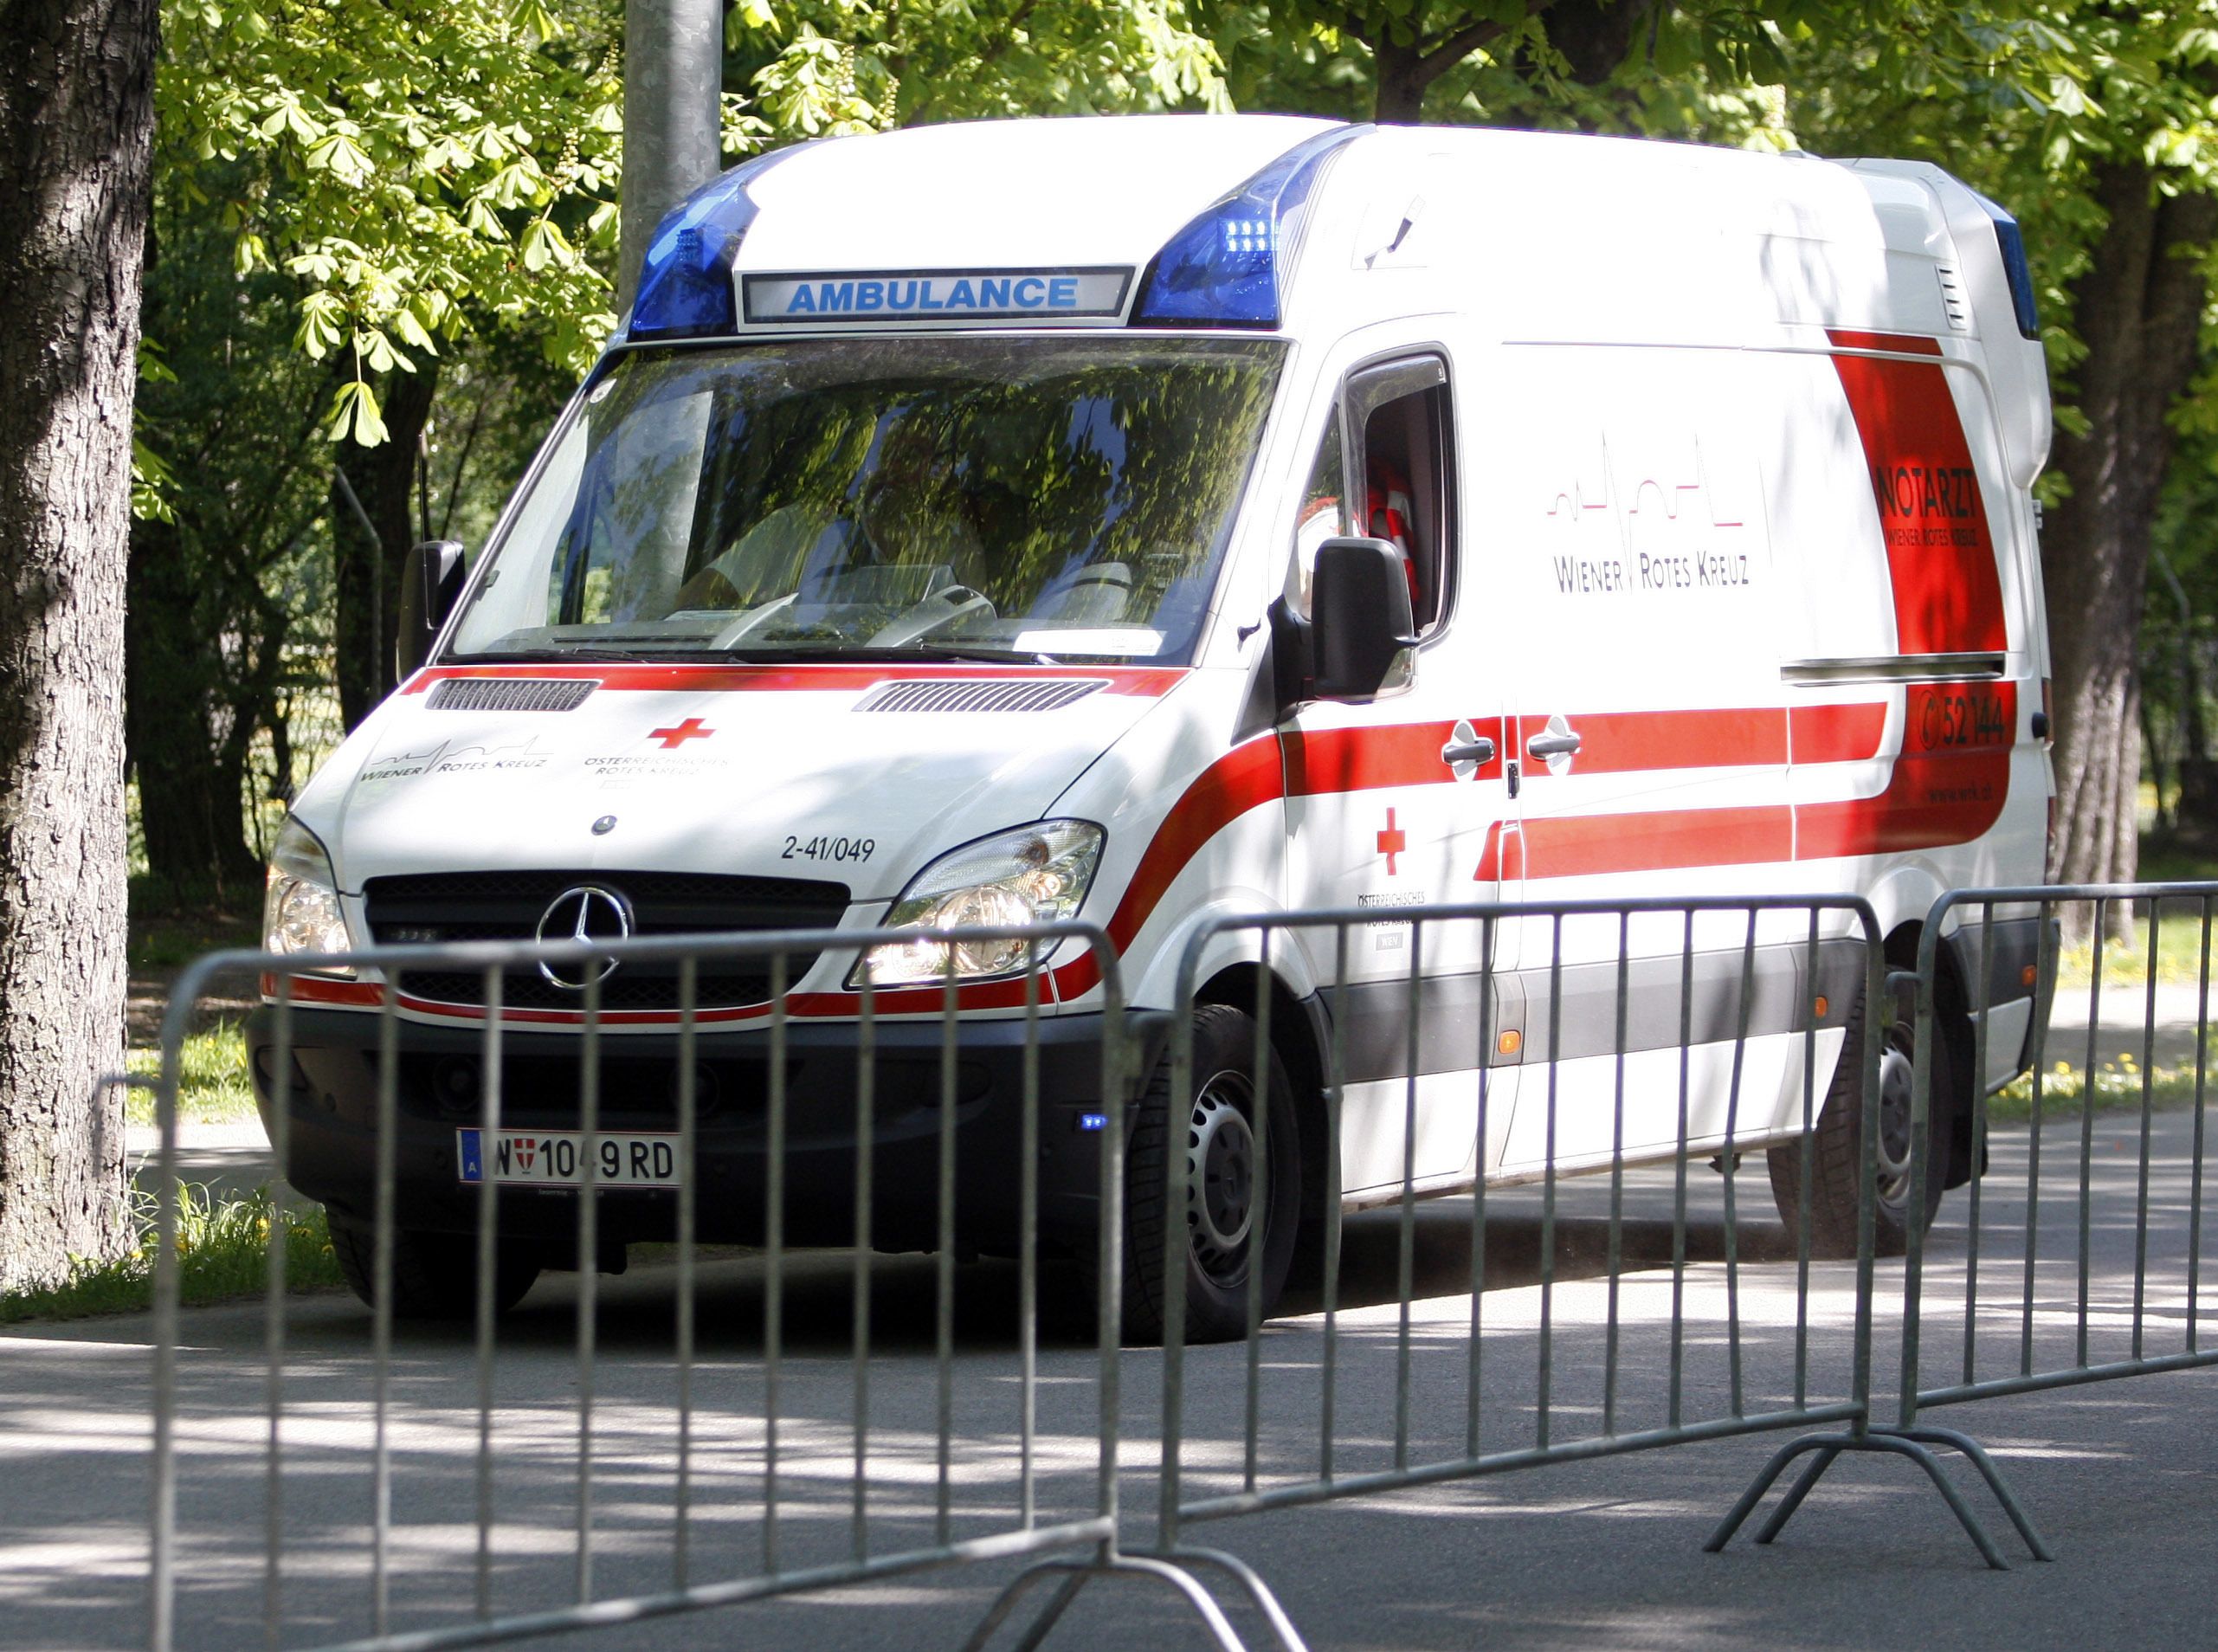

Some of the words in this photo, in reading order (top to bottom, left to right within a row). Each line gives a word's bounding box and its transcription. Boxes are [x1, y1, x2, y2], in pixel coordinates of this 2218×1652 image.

[786, 278, 1079, 313] AMBULANCE
[1876, 467, 1976, 518] NOTARZT
[360, 767, 422, 782] WIENER
[437, 761, 488, 772] ROTES
[494, 758, 548, 770] KREUZ
[782, 836, 876, 862] 2-41/049
[467, 1162, 477, 1173] A
[630, 1141, 674, 1178] RD
